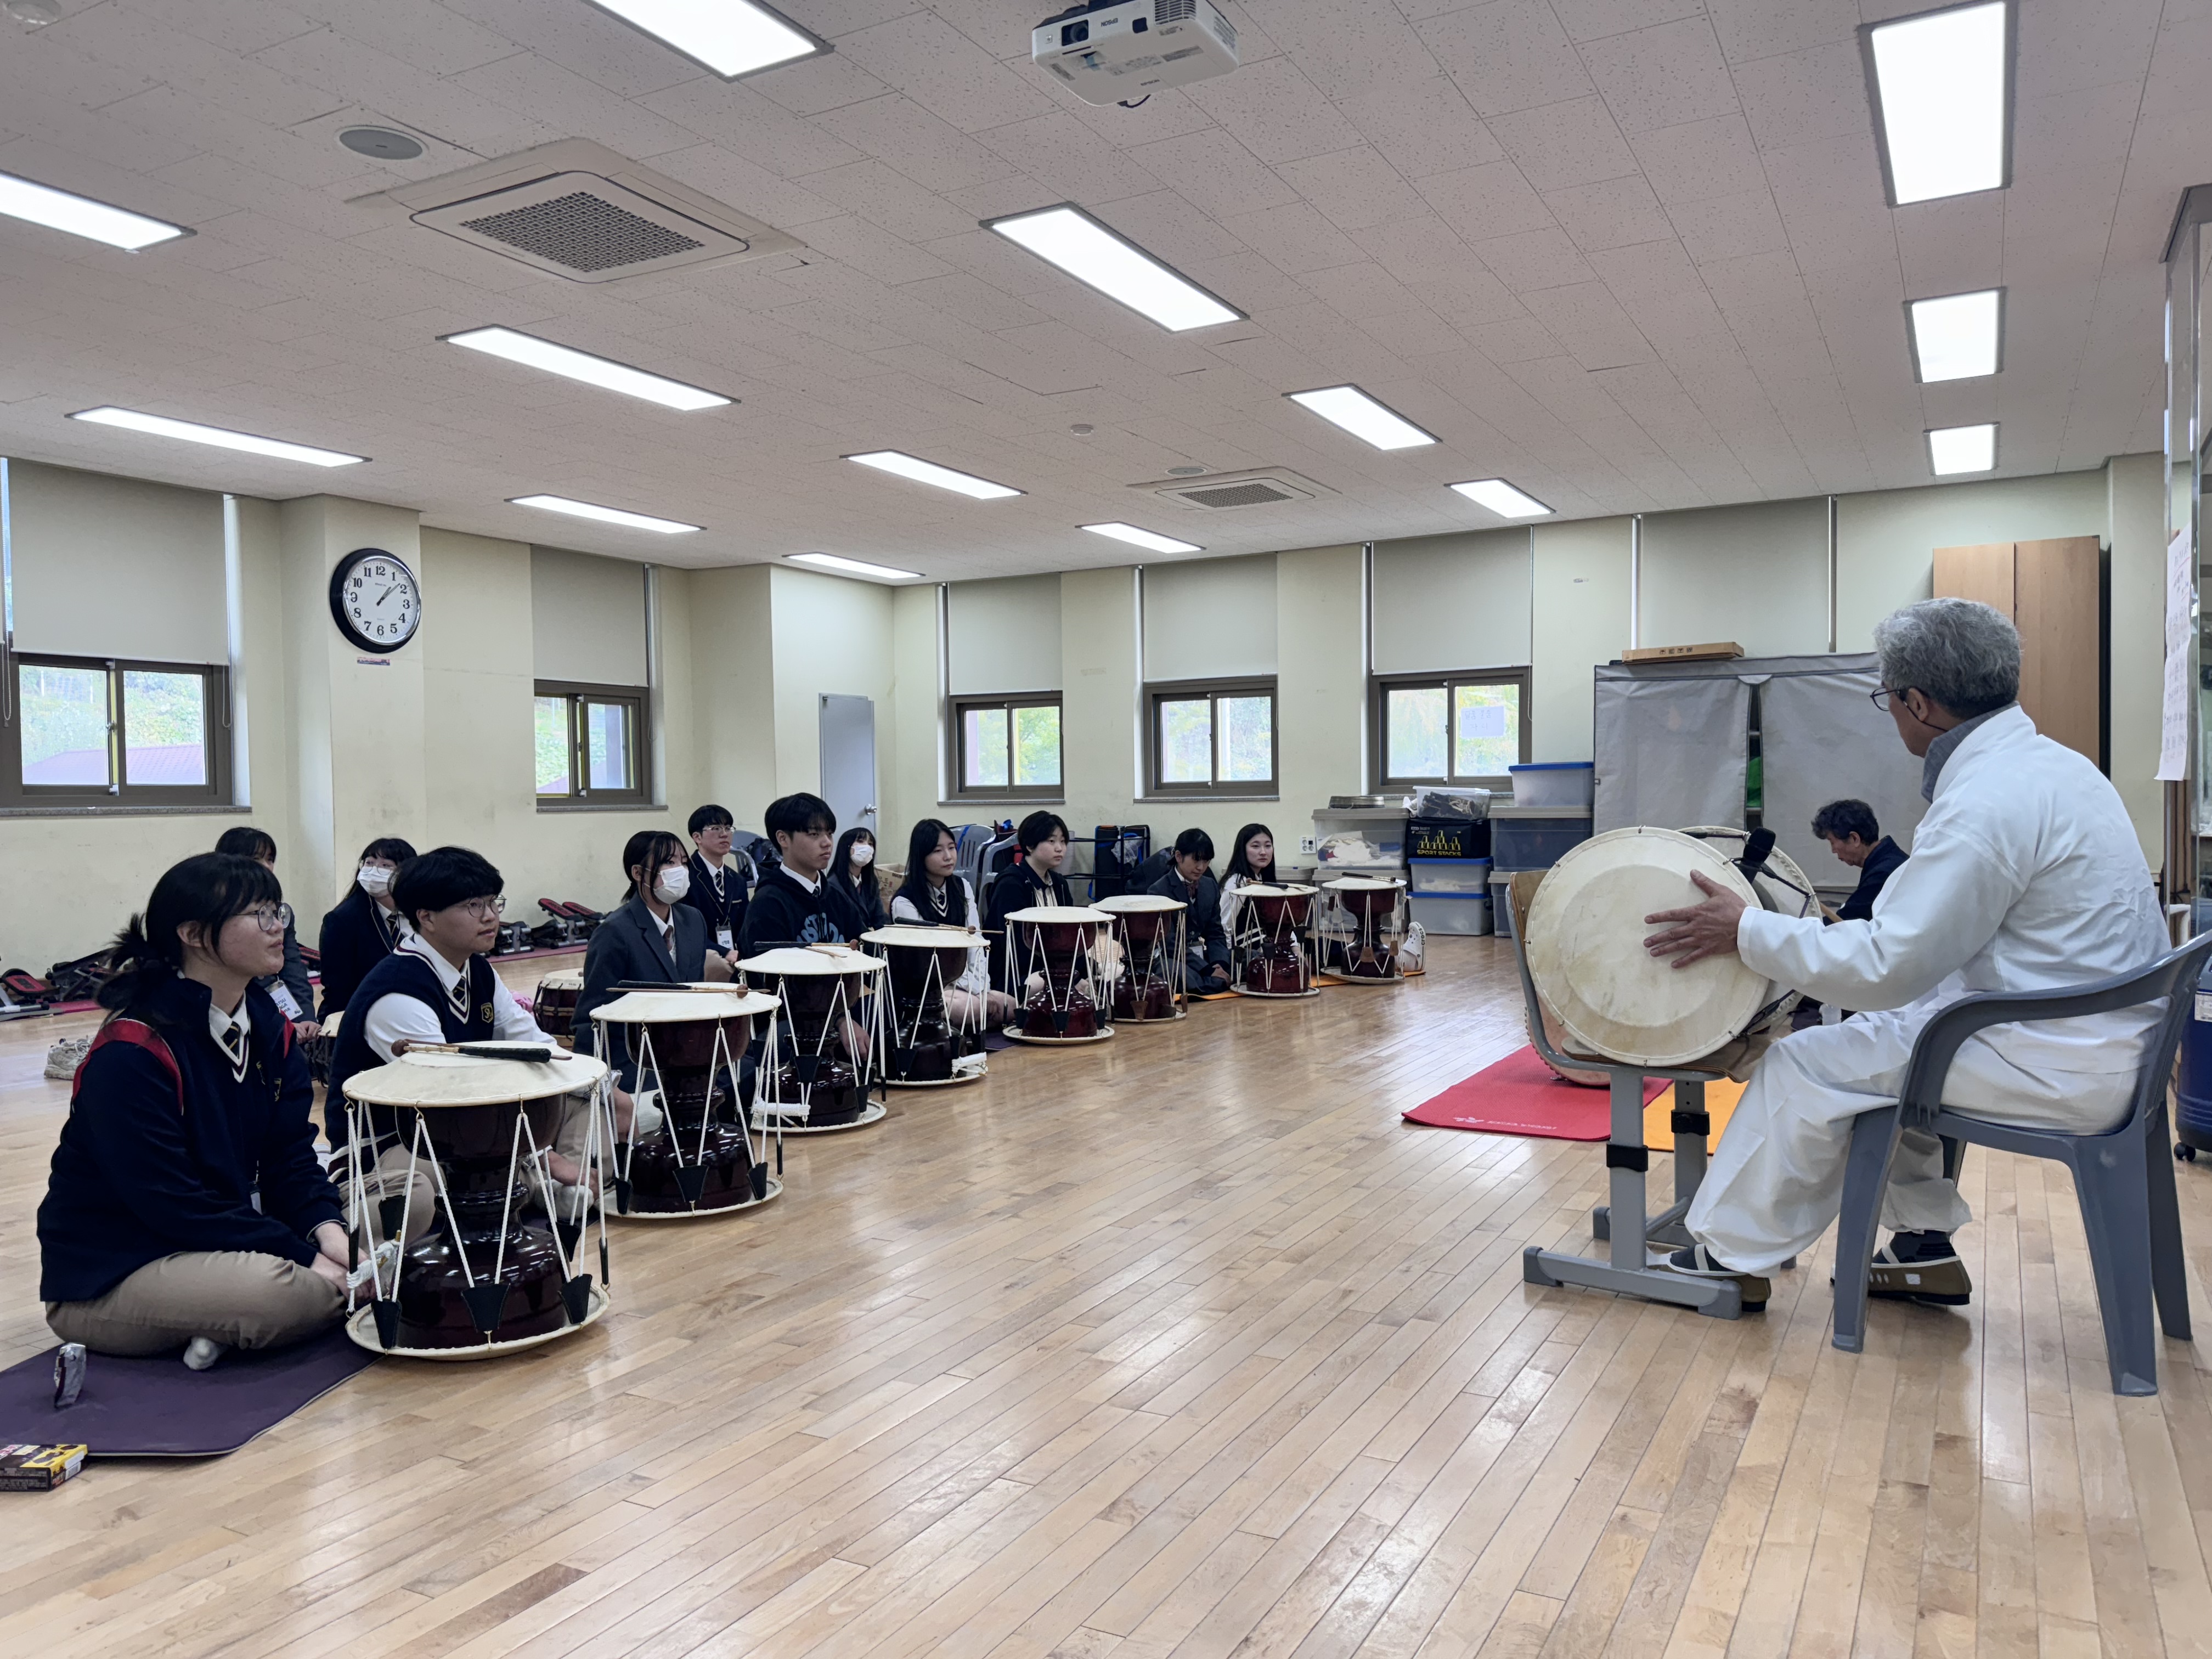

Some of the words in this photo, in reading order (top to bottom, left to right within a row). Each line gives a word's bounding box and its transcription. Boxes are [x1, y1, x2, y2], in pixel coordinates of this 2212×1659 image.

[1101, 18, 1119, 27] EPSON
[364, 567, 371, 577] 11
[375, 566, 386, 576] 12
[392, 572, 396, 581] 1
[353, 578, 362, 588] 10
[400, 584, 407, 594] 2
[350, 592, 358, 602] 9
[403, 599, 410, 609] 3
[354, 608, 361, 618] 8
[398, 613, 405, 623] 4
[364, 621, 371, 631] 7
[377, 625, 384, 635] 6
[390, 623, 397, 633] 5
